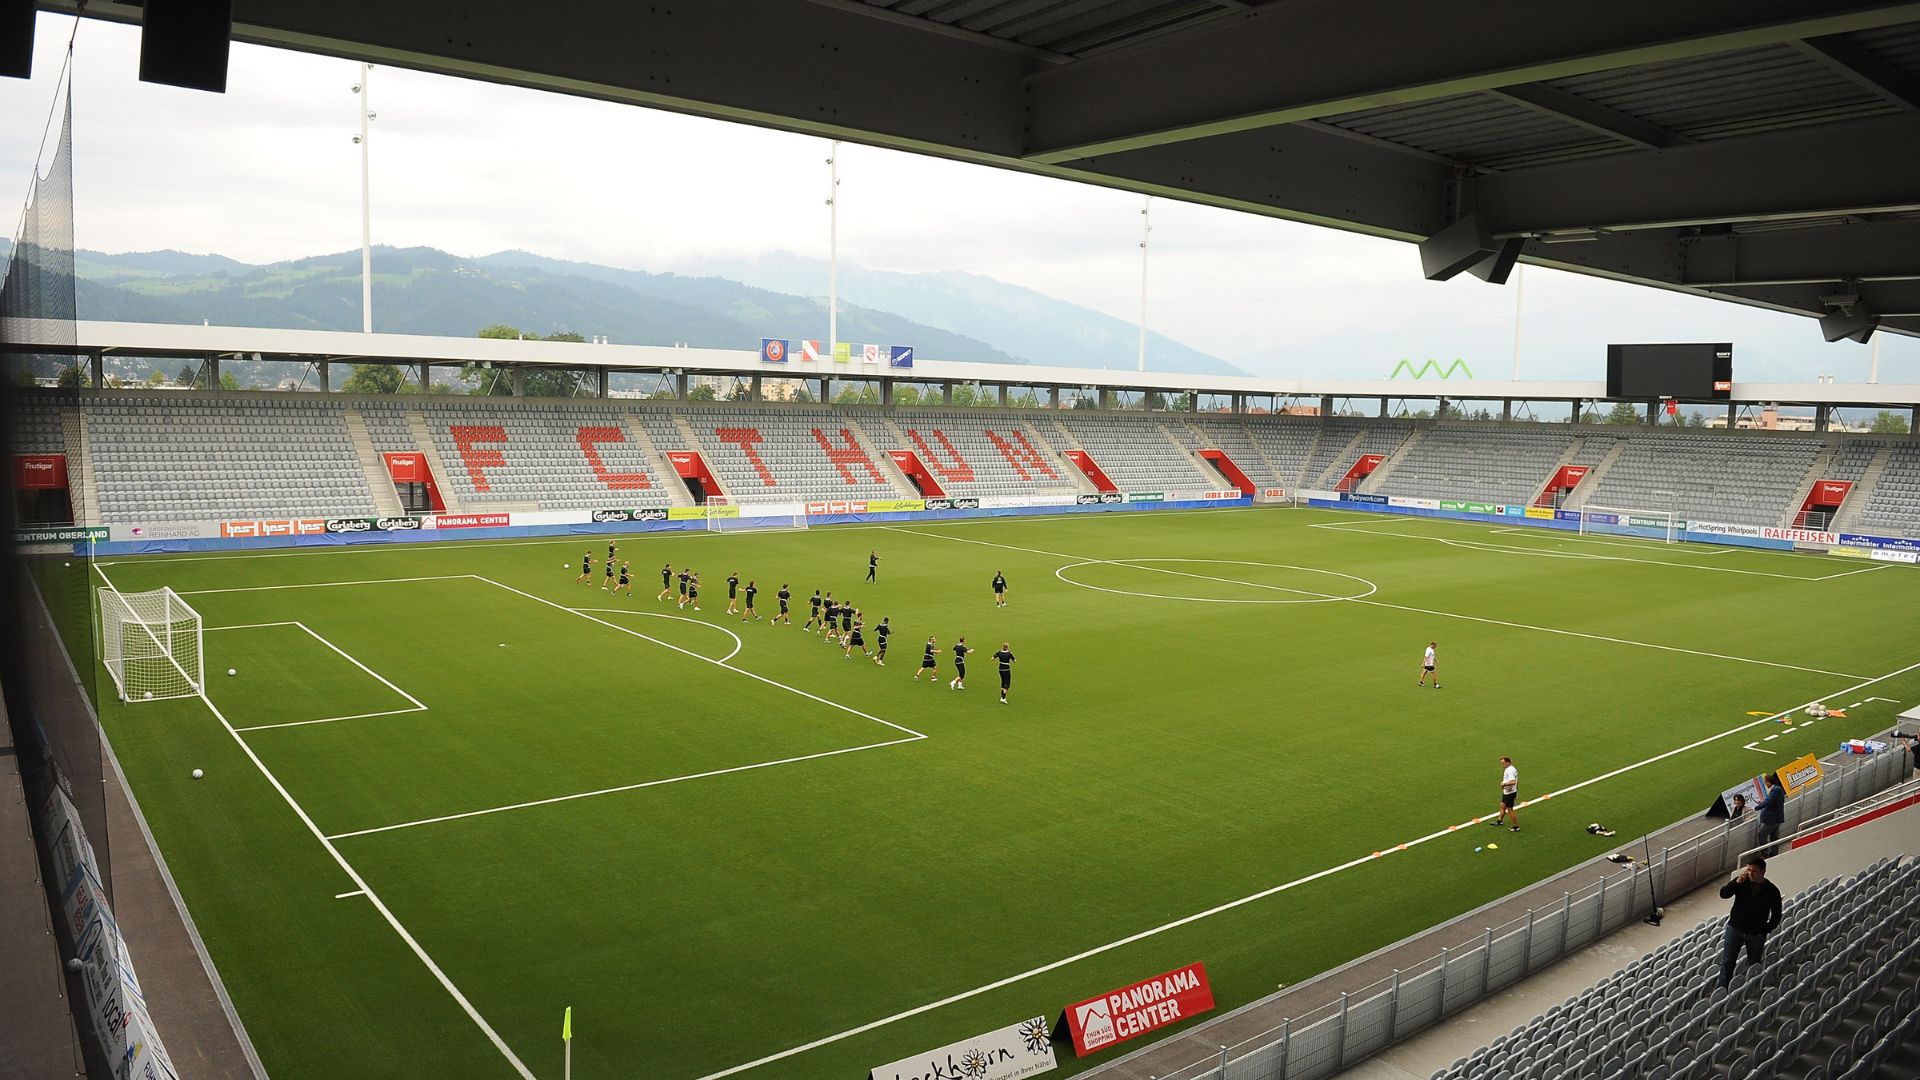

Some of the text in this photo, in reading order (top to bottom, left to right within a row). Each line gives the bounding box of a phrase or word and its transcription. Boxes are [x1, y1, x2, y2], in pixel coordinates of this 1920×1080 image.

[26, 462, 53, 470] Frutiger
[1205, 491, 1221, 499] OBI
[1266, 489, 1284, 497] OBI
[926, 500, 951, 510] Carlsberg
[953, 499, 978, 509] Carlsberg
[438, 516, 509, 526] PANORAMA CENTER
[593, 509, 667, 522] Carlsberg Carlsberg
[326, 517, 420, 532] Carlsberg Carlsberg
[1698, 523, 1758, 535] HotSpring Whirlpools
[58, 530, 107, 539] OBERLAND
[1764, 528, 1835, 543] RAIFFEISEN
[1840, 539, 1880, 548] Intermakler
[1110, 969, 1201, 1015] PANORAMA
[1116, 999, 1181, 1037] CENTER
[1086, 1025, 1112, 1039] THUN SÜD
[1087, 1034, 1114, 1047] SHOPPING
[1021, 1066, 1034, 1074] Ihrer
[1035, 1059, 1052, 1069] Nähe!
